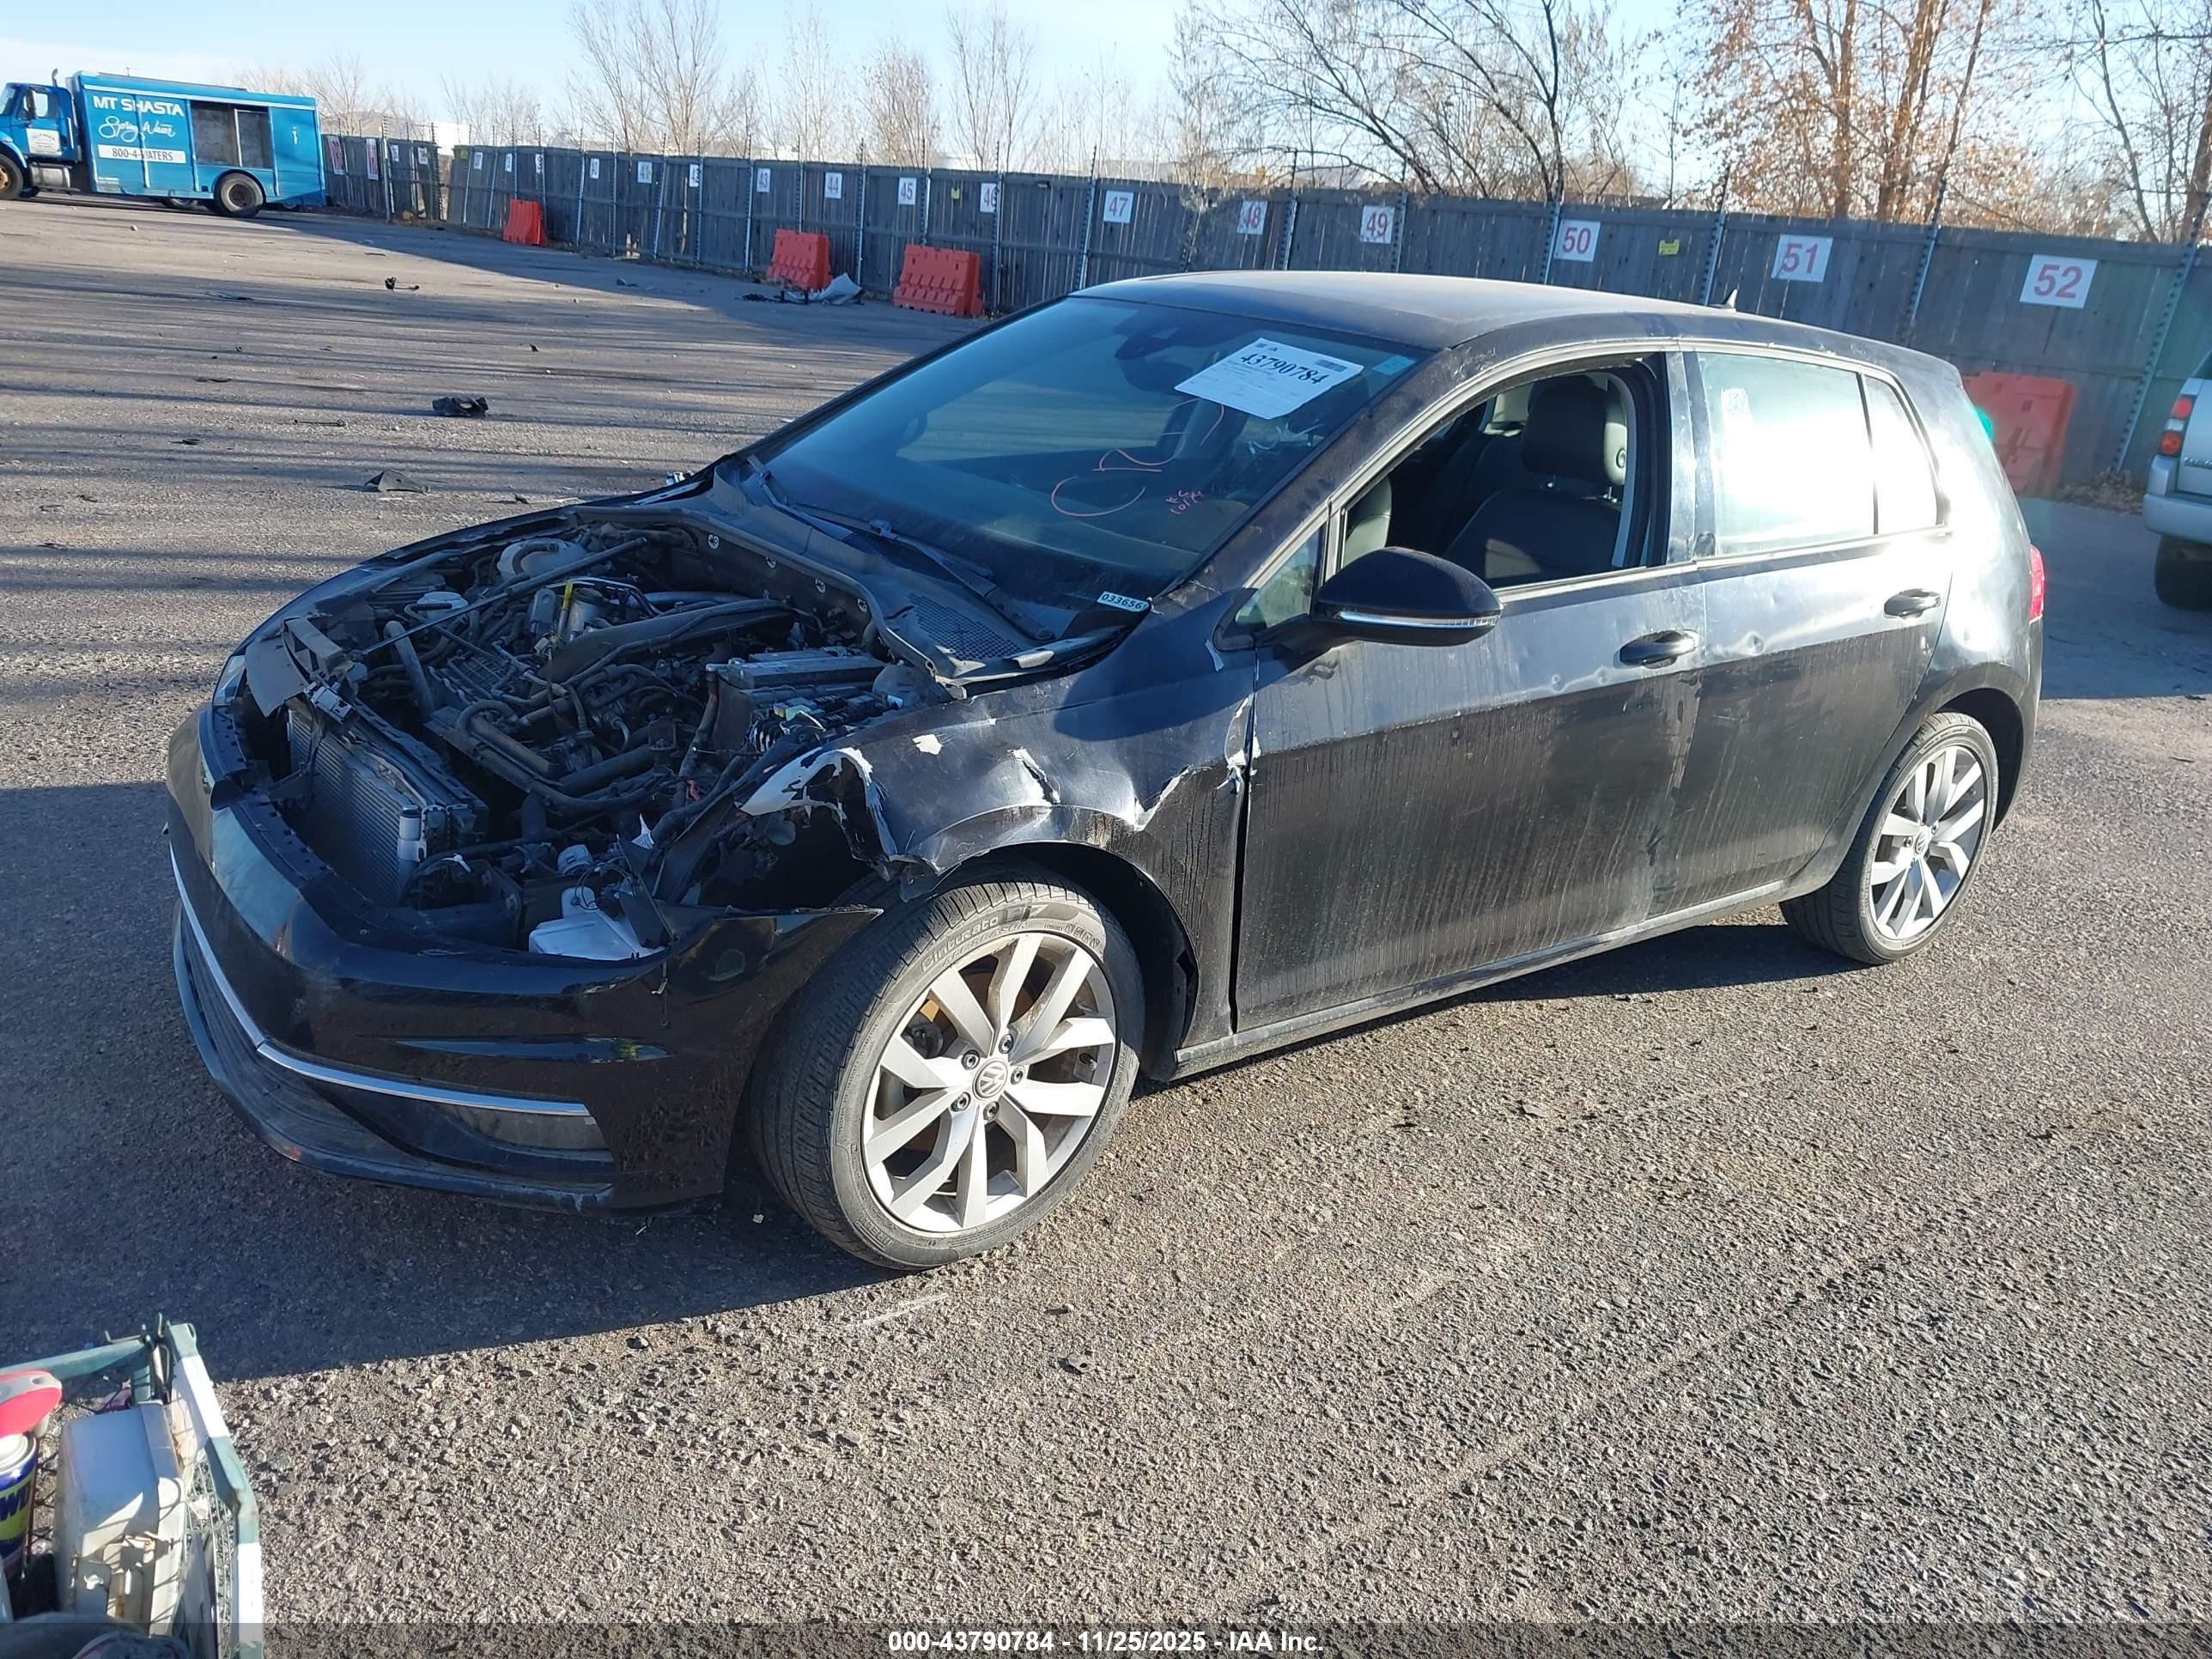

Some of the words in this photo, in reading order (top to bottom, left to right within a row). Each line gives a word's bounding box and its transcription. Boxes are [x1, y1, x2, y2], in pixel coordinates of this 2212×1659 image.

[93, 96, 118, 110] MT
[121, 98, 185, 117] SHASTA
[827, 177, 839, 193] 44
[900, 182, 913, 199] 45
[1109, 197, 1128, 217] 47
[1244, 204, 1261, 228] 48
[1366, 212, 1389, 236] 49
[1562, 226, 1592, 254] 50
[1782, 243, 1818, 274] 51
[2033, 264, 2082, 298] 52
[1241, 353, 1330, 385] 43790784
[1101, 593, 1144, 610] 033656
